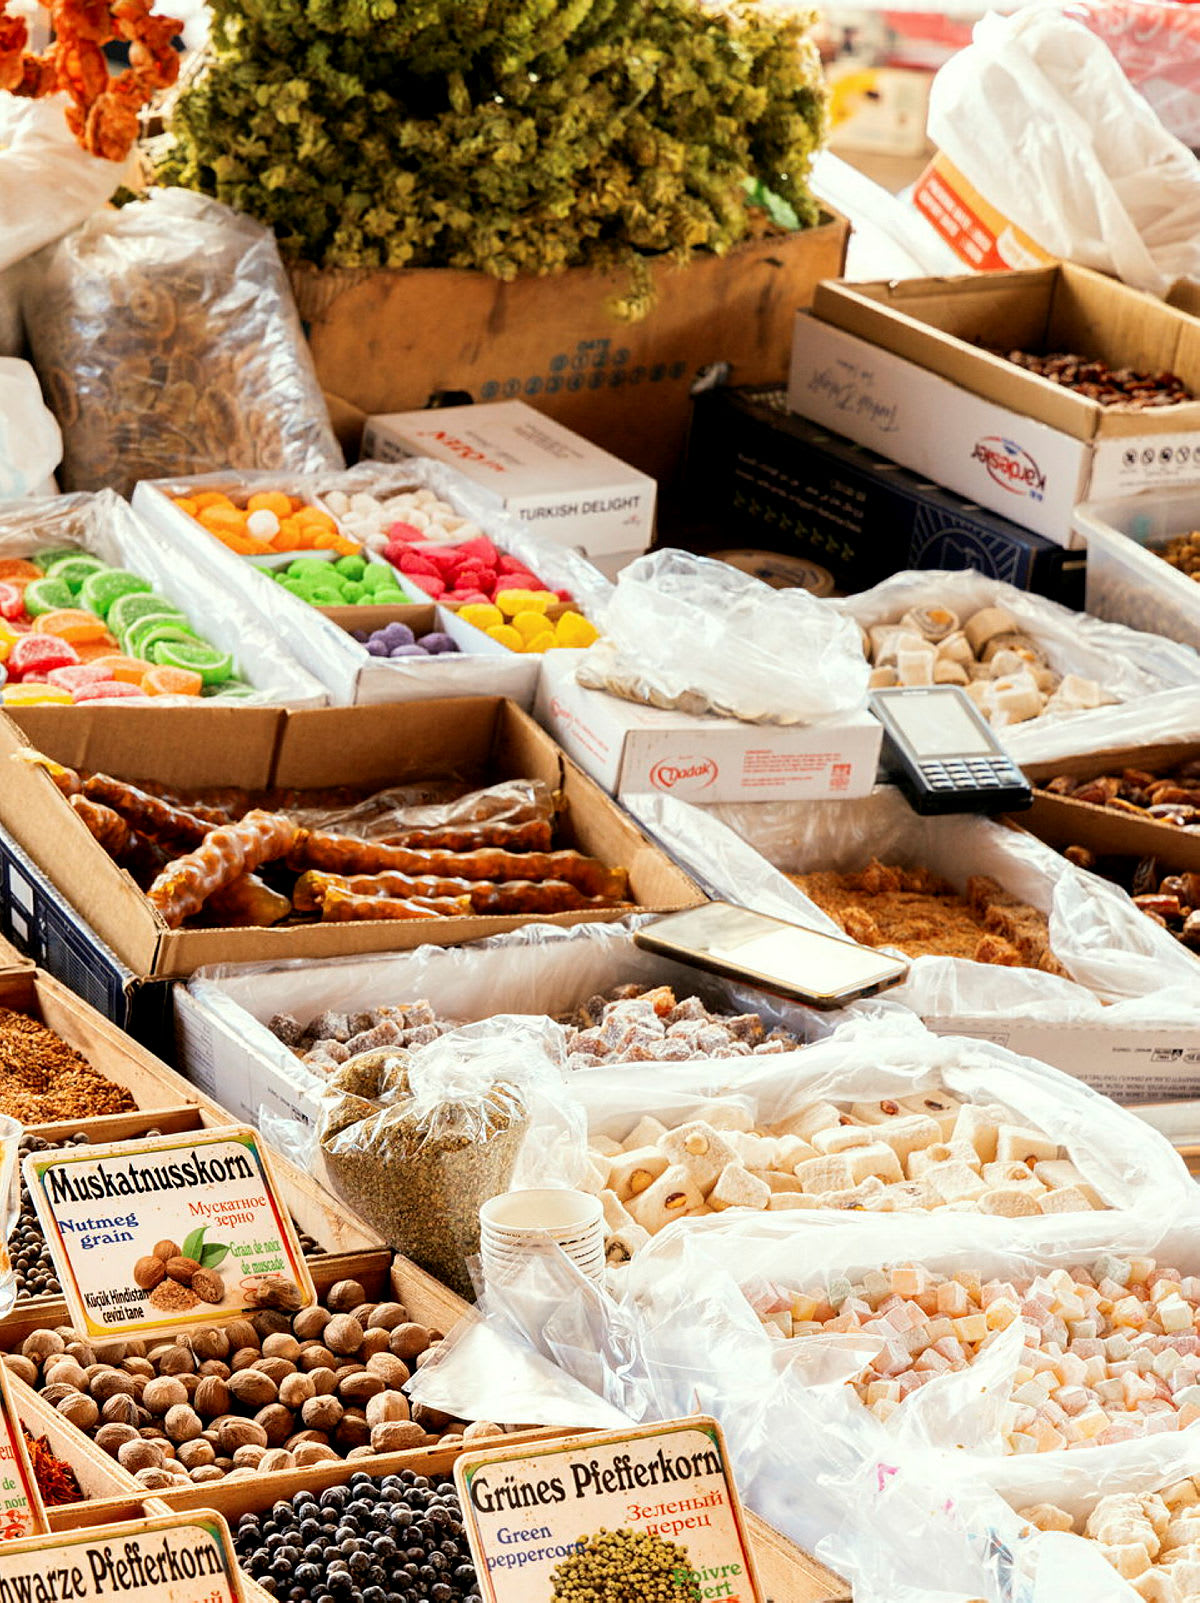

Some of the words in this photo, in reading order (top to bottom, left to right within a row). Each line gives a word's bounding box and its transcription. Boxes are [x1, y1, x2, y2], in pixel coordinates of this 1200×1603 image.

[520, 503, 578, 521] TURKISH
[582, 496, 641, 514] DELIGHT
[47, 1151, 254, 1204] Muskatnusskorn
[188, 1195, 267, 1217] Мускатное
[58, 1212, 139, 1233] Nutmeg
[214, 1211, 255, 1228] зерно
[80, 1229, 134, 1250] grain
[102, 1307, 126, 1324] cevizi
[125, 1305, 145, 1320] tane
[2, 1478, 16, 1492] de
[471, 1474, 566, 1513] Grünes
[570, 1449, 723, 1498] Pfefferkorn
[2, 1494, 28, 1510] noir
[626, 1489, 725, 1523] Зеленый
[497, 1526, 552, 1546] Green
[646, 1514, 711, 1539] перец
[86, 1537, 224, 1595] Pfefferkorn
[485, 1541, 586, 1572] peppercorn
[673, 1562, 743, 1588] Poivre
[690, 1580, 734, 1601] vert
